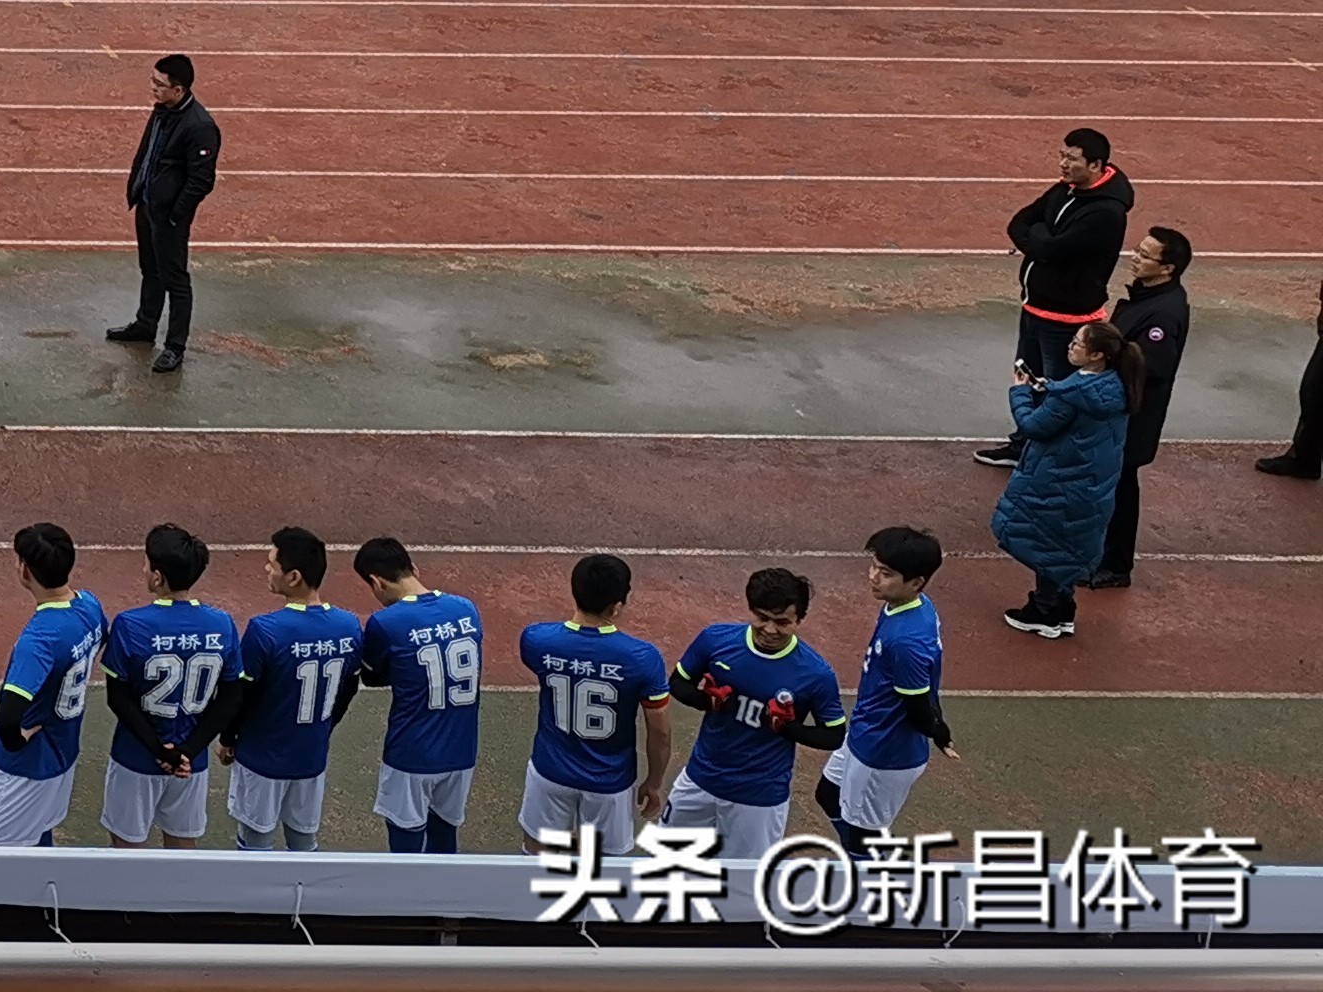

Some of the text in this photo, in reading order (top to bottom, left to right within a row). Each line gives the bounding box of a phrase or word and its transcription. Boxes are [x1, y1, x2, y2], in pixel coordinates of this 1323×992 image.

[151, 632, 224, 652] 柯桥区
[291, 637, 355, 658] 柯桥区
[408, 616, 477, 646] 柯桥区
[417, 637, 479, 710] 19
[542, 652, 625, 682] 柯桥区
[141, 652, 224, 719] 20
[296, 657, 345, 724] 11
[546, 673, 619, 741] 16
[735, 694, 765, 729] 10
